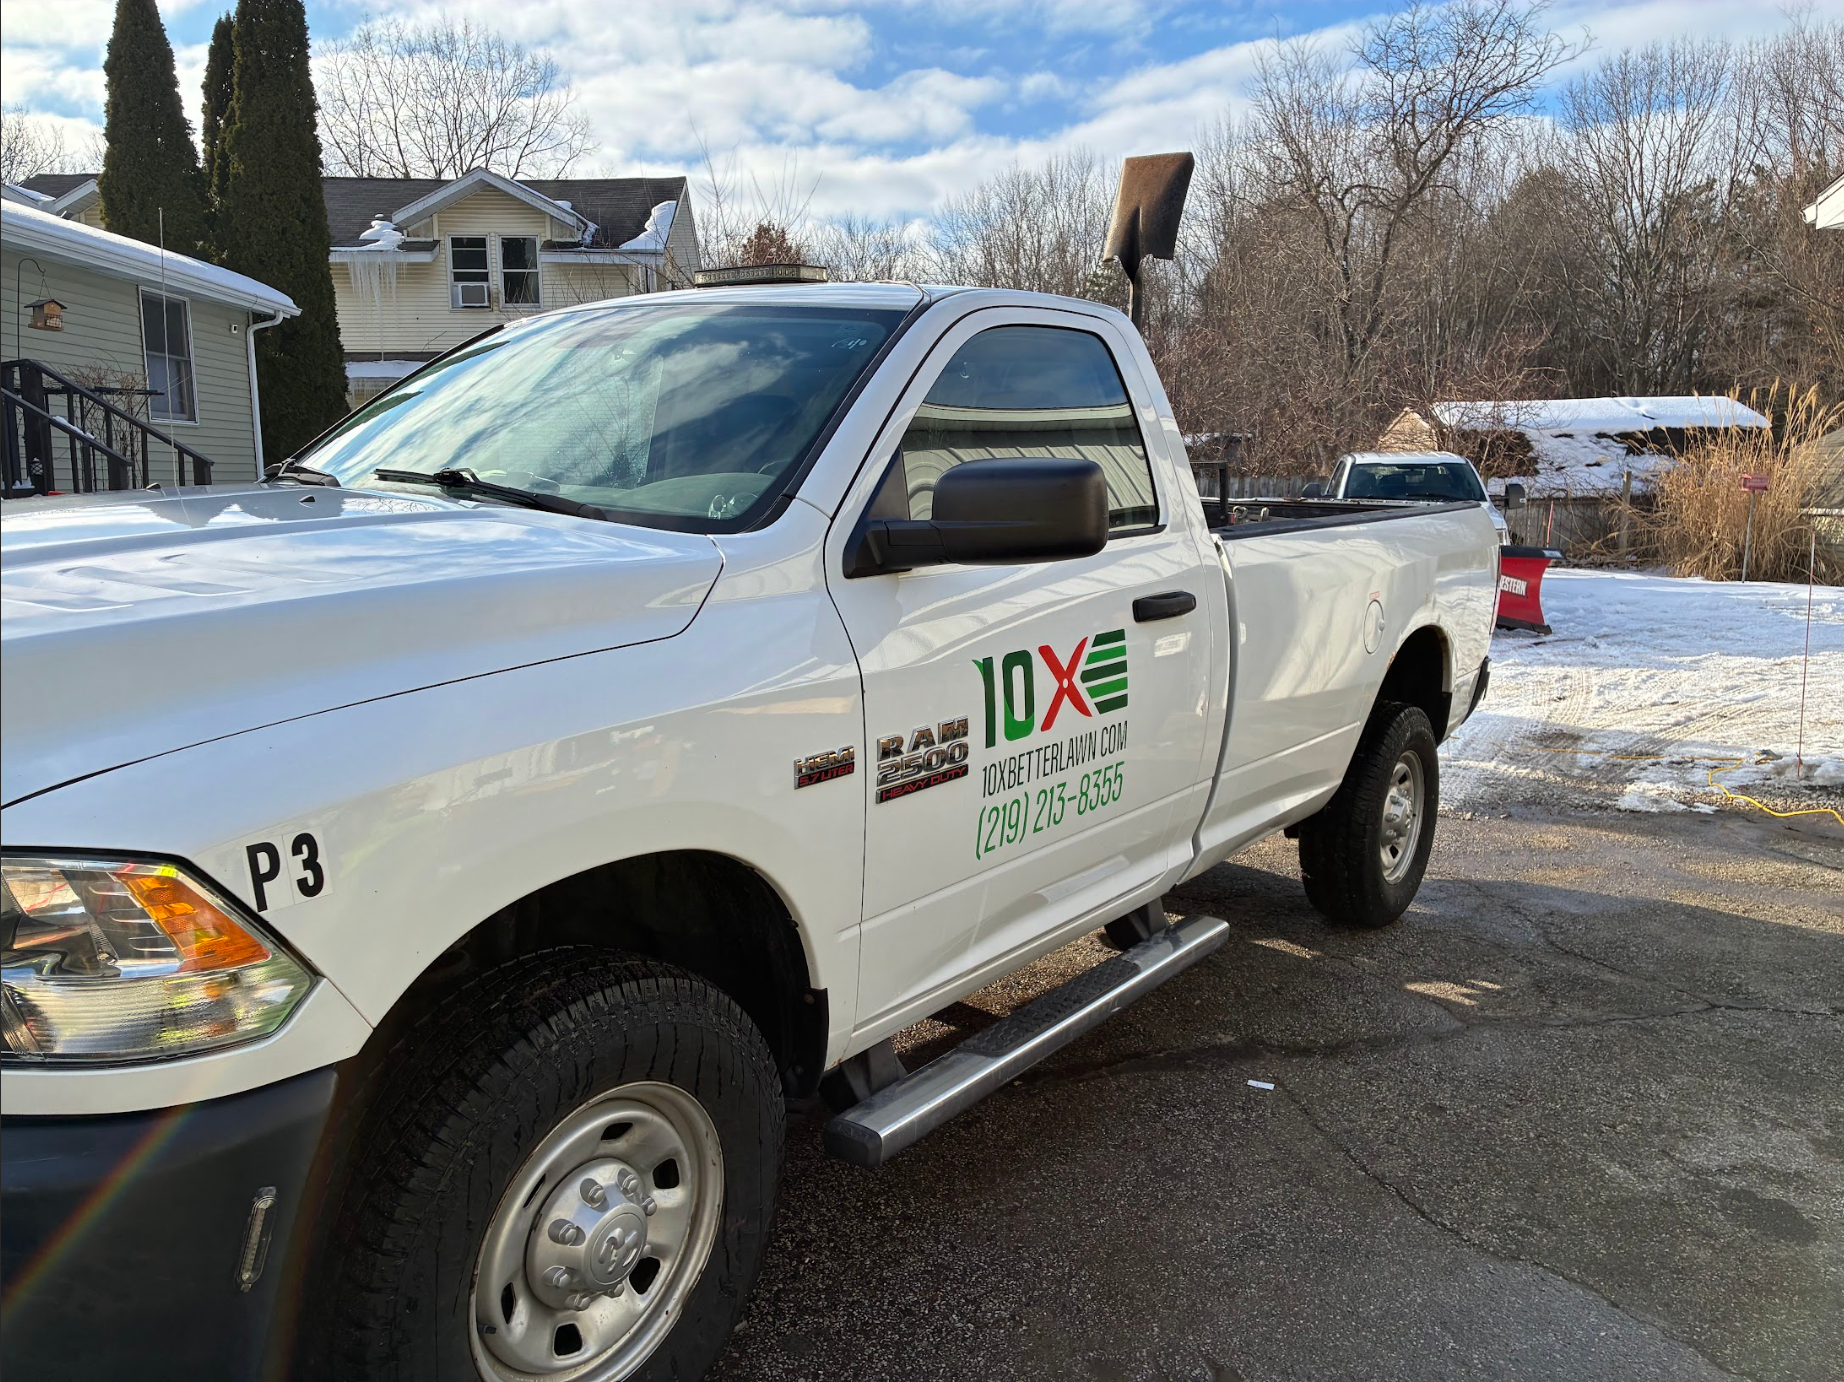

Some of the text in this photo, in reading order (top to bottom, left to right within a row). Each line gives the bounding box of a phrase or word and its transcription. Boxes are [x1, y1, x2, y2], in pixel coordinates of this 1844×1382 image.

[794, 745, 855, 776] HEMI
[877, 715, 968, 762] RAM
[982, 720, 1128, 799] 10XBETTERLAWN COM
[799, 764, 854, 787] 5.7 LITER
[877, 740, 969, 787] 2500
[882, 767, 967, 801] HEAVY DUTY
[975, 761, 1125, 861] (219) 213-8355
